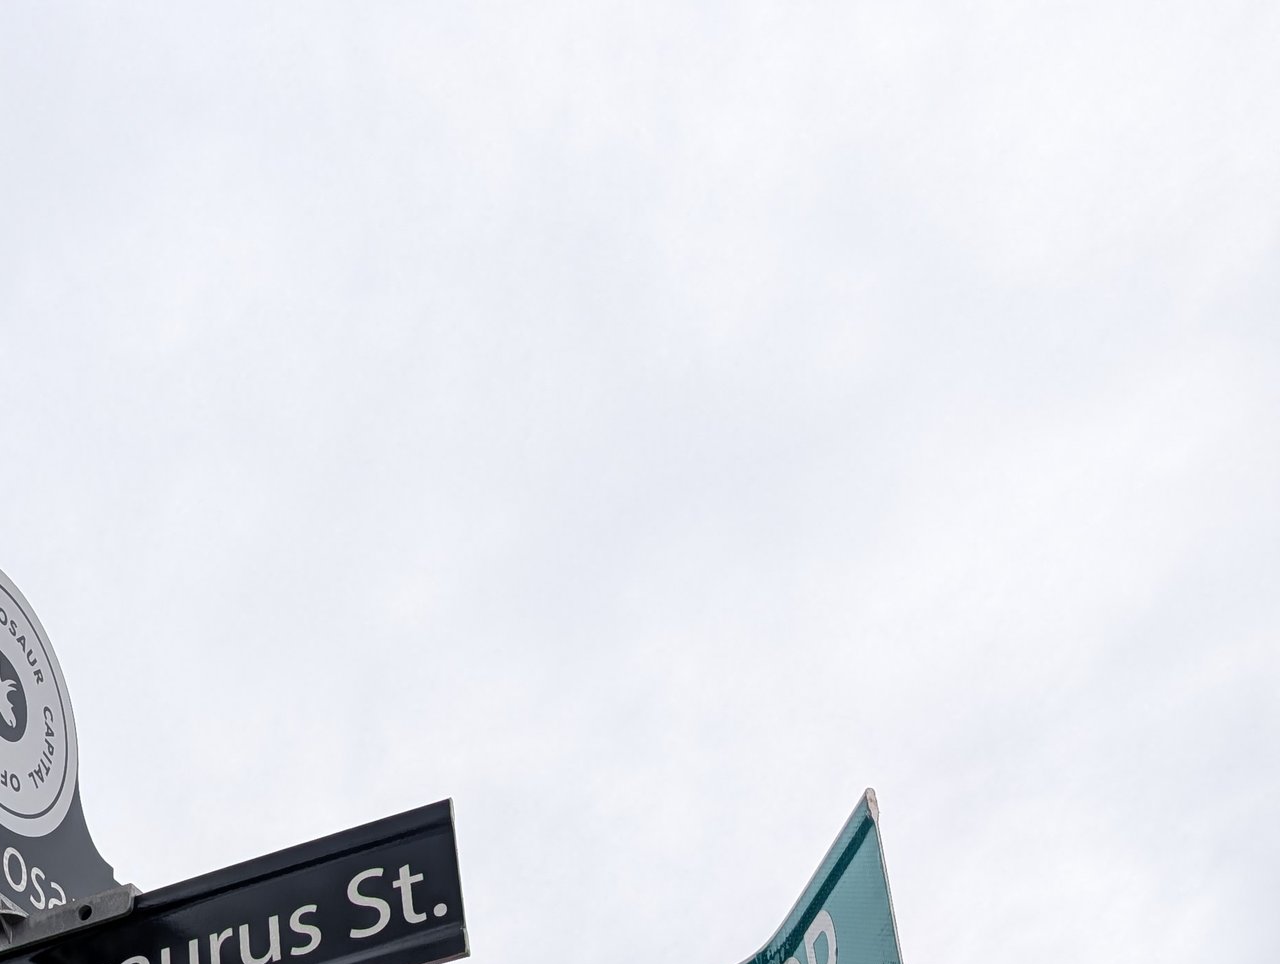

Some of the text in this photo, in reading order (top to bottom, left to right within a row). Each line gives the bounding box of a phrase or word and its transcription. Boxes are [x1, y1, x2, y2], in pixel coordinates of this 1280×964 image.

[0, 769, 21, 792] OF
[28, 705, 55, 789] CAPITAL
[346, 863, 449, 939] St.
